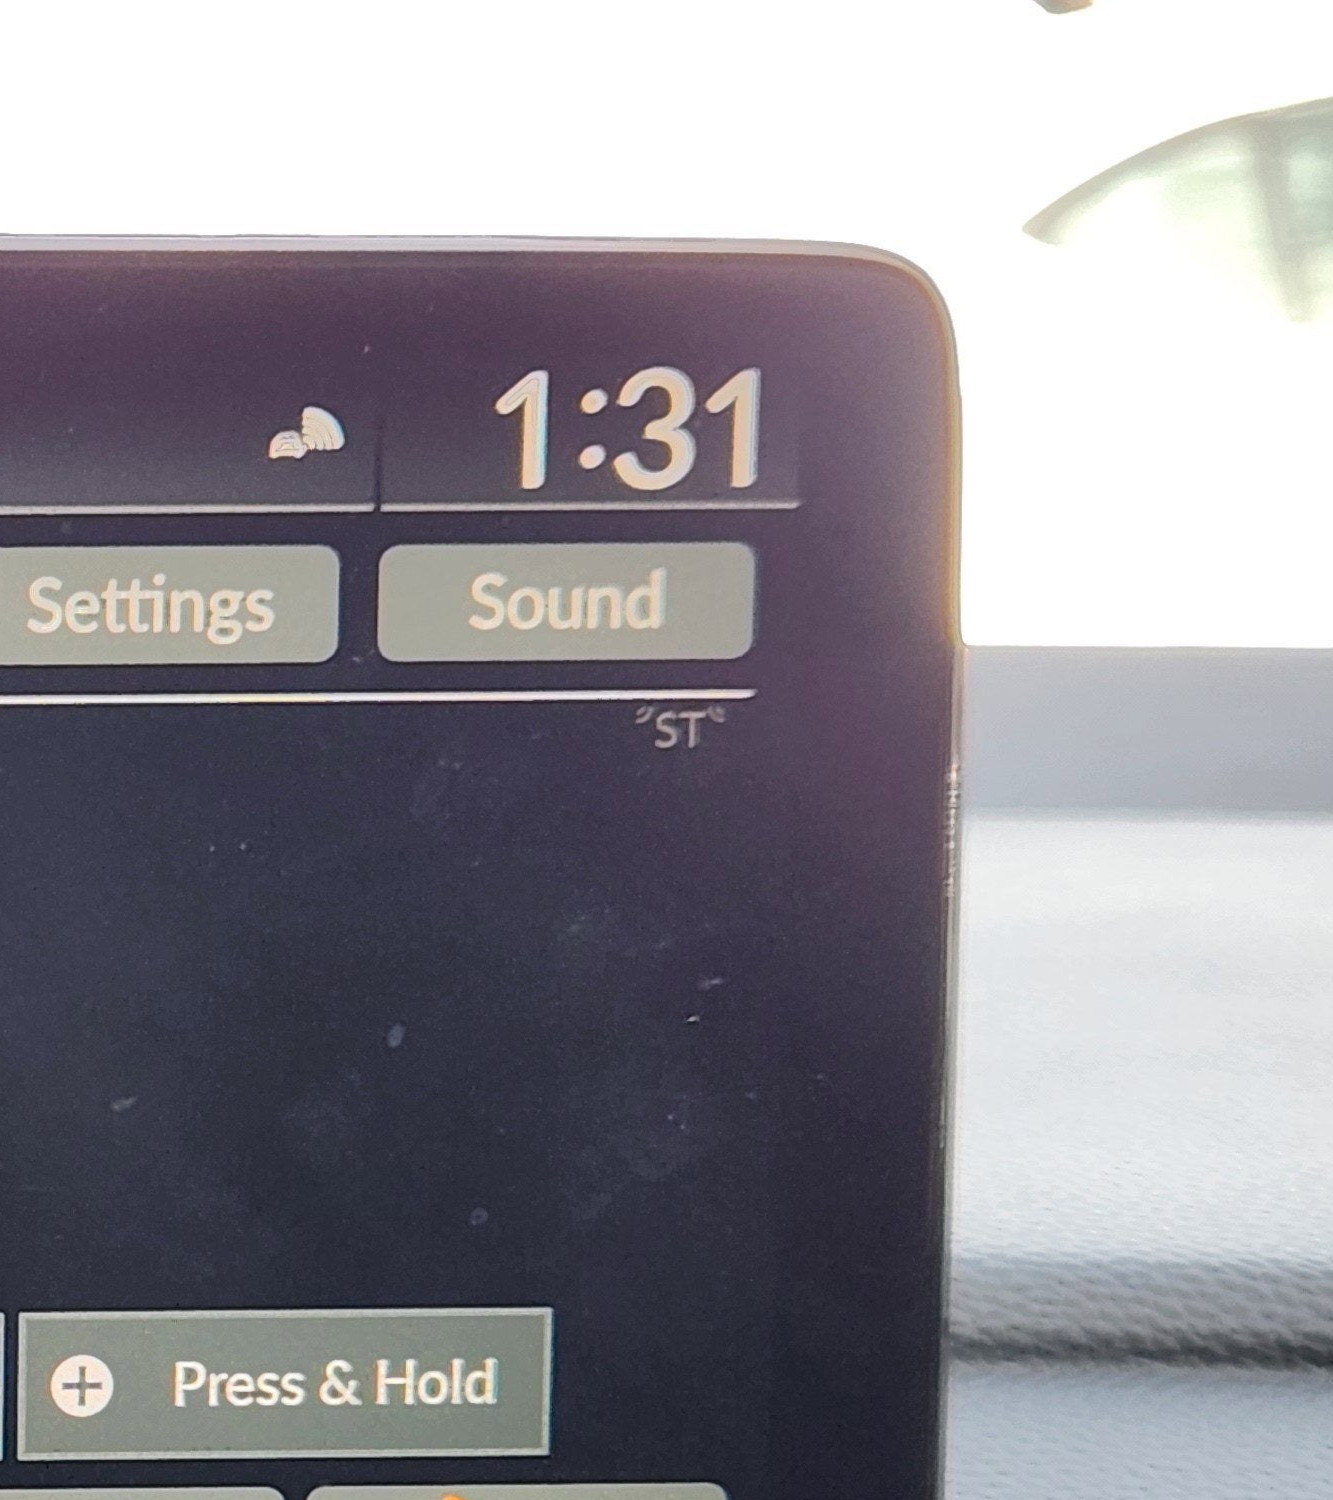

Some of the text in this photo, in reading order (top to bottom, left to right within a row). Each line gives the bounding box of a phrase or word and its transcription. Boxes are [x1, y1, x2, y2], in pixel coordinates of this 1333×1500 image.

[496, 366, 762, 491] 1:31
[27, 577, 275, 644] Settings
[469, 568, 667, 631] Sound
[173, 1358, 499, 1409] Press & Hold
